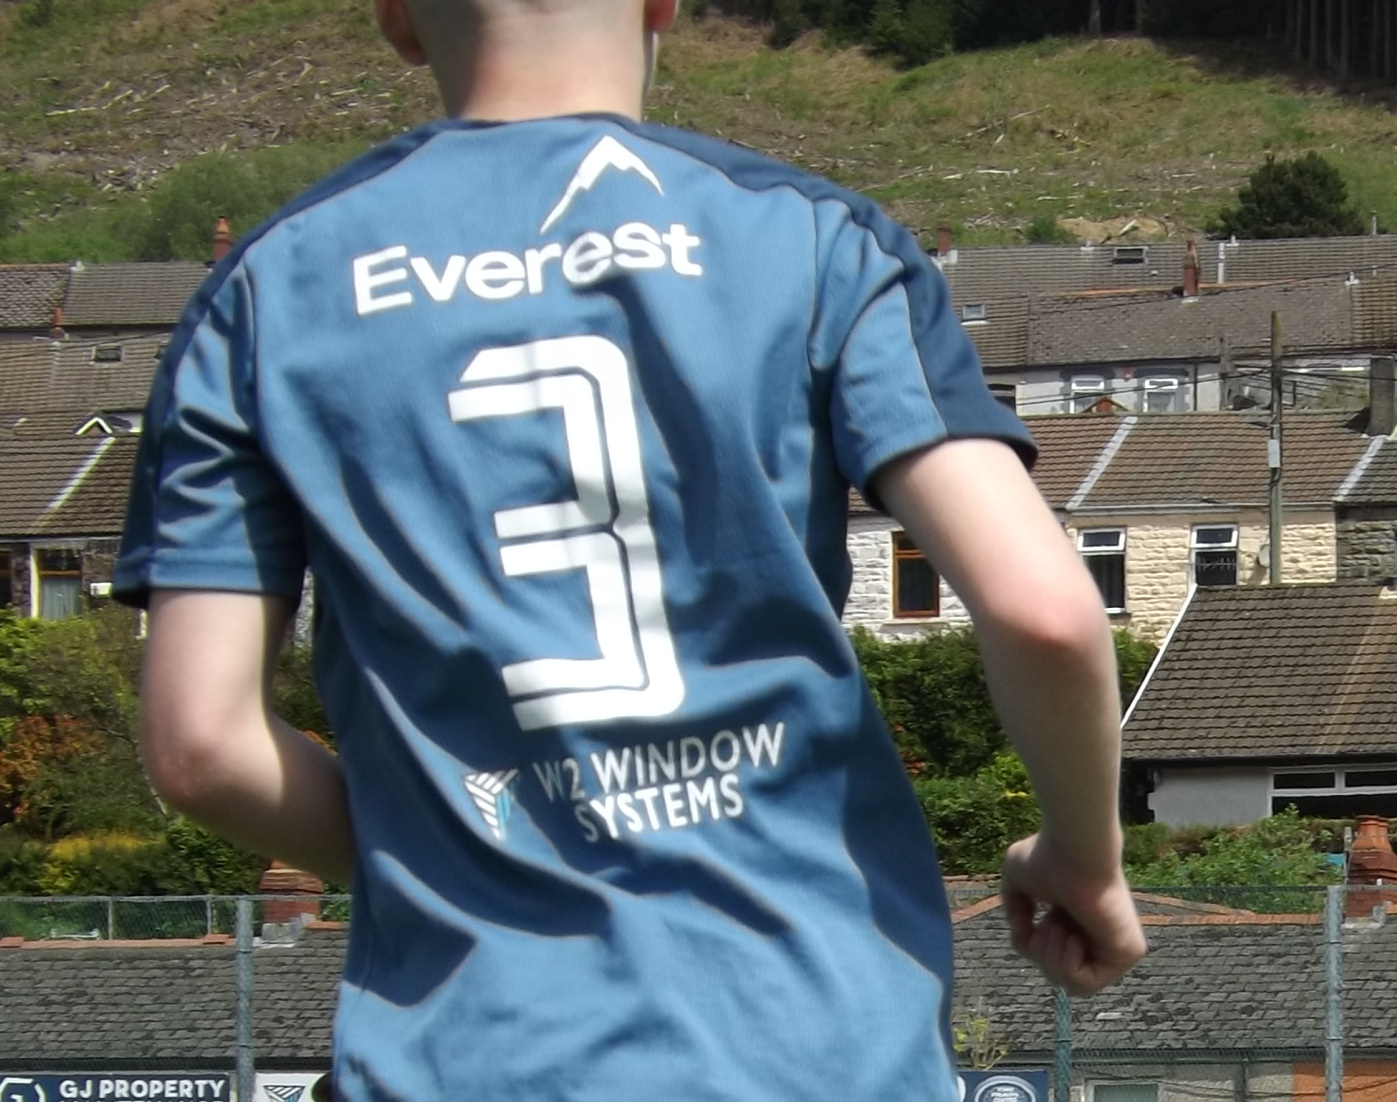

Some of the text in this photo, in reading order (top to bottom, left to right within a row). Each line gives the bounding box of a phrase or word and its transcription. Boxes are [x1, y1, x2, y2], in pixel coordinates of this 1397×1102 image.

[353, 222, 703, 316] Everest
[448, 335, 685, 731] 3
[532, 722, 785, 802] W2 WINDOW
[575, 776, 746, 842] SYSTEMS
[59, 1079, 225, 1099] GJ PROPERTY
